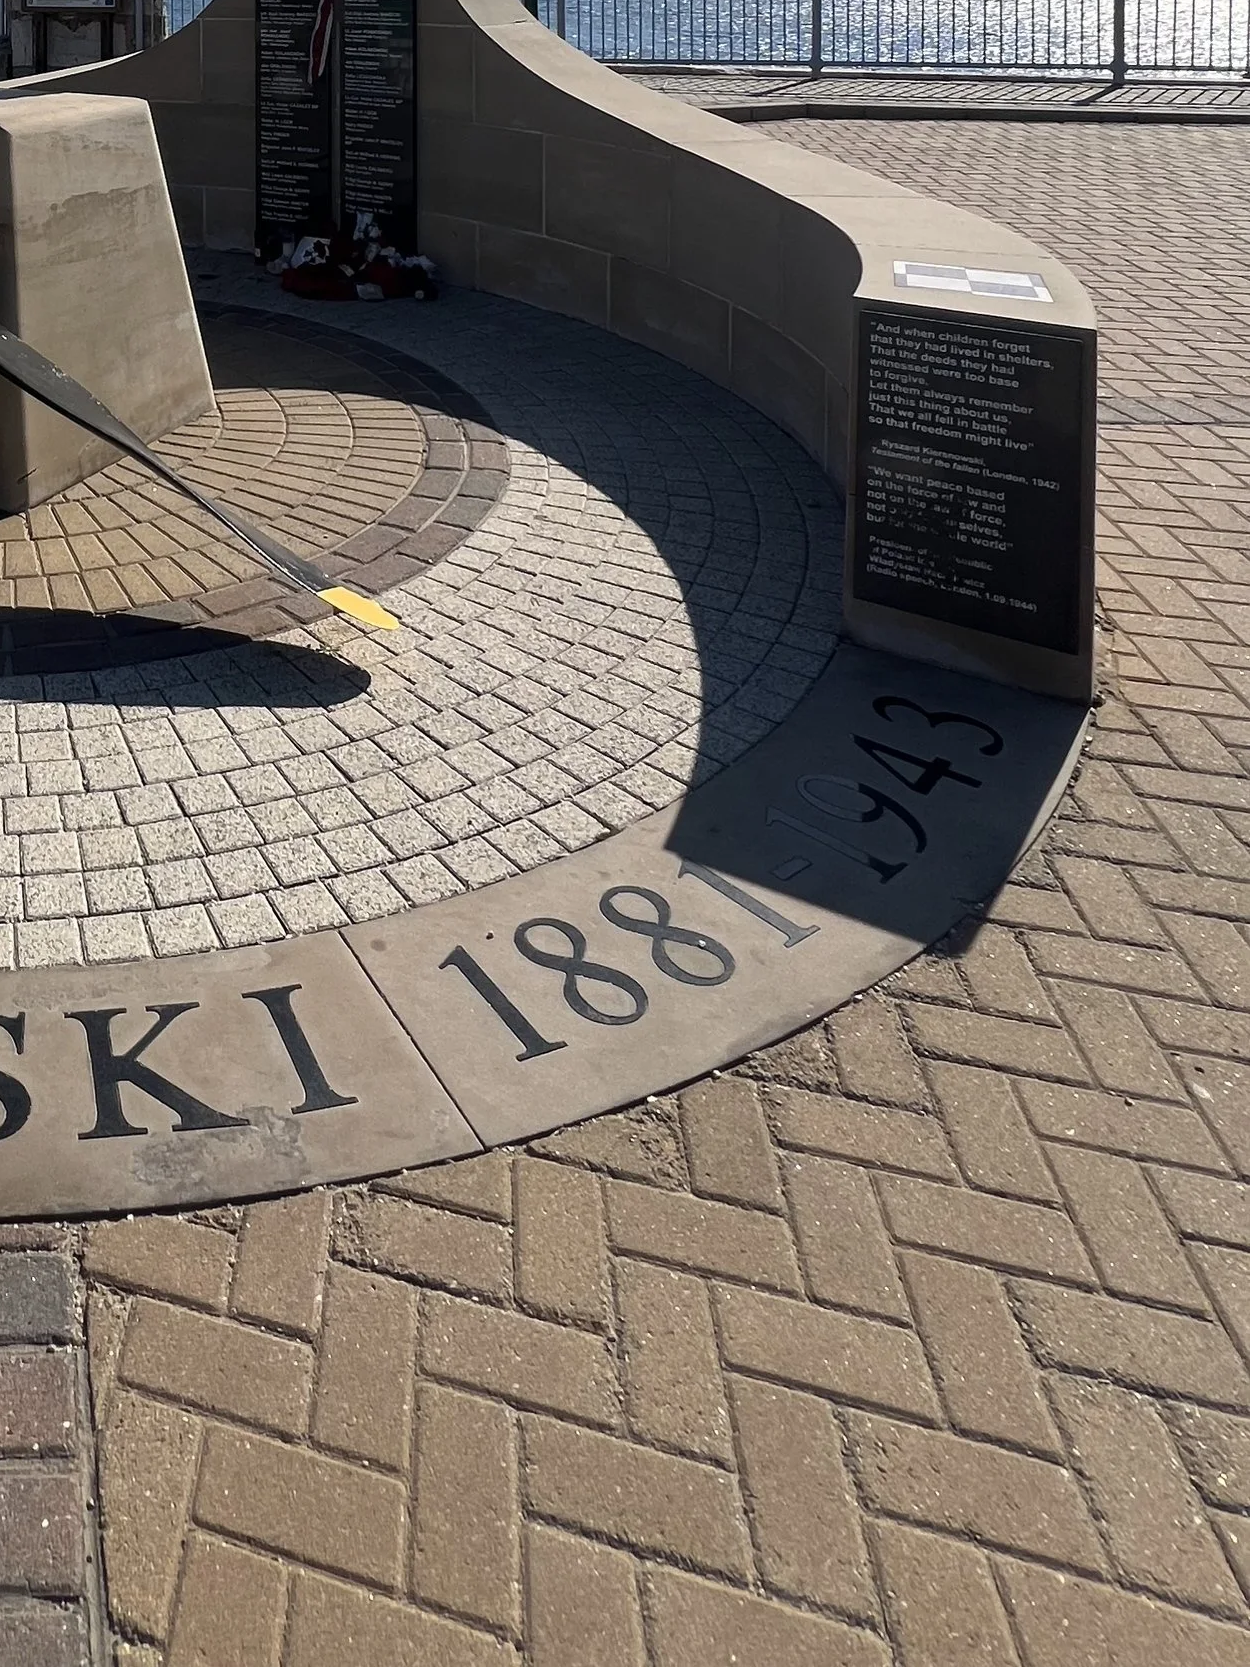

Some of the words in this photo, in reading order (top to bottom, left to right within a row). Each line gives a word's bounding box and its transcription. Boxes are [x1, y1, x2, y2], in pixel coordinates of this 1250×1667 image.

[870, 334, 892, 344] that
[896, 338, 921, 350] they
[925, 342, 947, 352] had
[951, 345, 980, 357] lived
[984, 350, 995, 359] in
[904, 328, 935, 339] when
[938, 333, 988, 346] children
[992, 339, 1030, 353] forget
[870, 344, 895, 356] That
[899, 350, 917, 359] the
[921, 353, 957, 366] deeds
[961, 359, 987, 372] they
[991, 363, 1015, 375] had
[870, 368, 881, 377] to
[870, 358, 929, 373] witnessed
[932, 368, 961, 379] were
[965, 372, 985, 382] too
[989, 375, 1019, 388] base
[868, 391, 891, 402] just
[894, 396, 916, 406] this
[919, 400, 950, 414] thing
[954, 407, 989, 419] about
[870, 380, 888, 390] Let
[891, 383, 920, 395] them
[923, 390, 965, 404] always
[969, 398, 1034, 414] remember
[868, 416, 883, 424] so
[886, 418, 908, 429] that
[912, 422, 962, 438] freedom
[965, 434, 1002, 446] might
[869, 402, 894, 415] That
[898, 410, 914, 418] we
[918, 413, 931, 421] all
[935, 414, 953, 425] fell
[957, 418, 968, 428] in
[972, 420, 1007, 435] battle
[872, 446, 920, 462] Testament
[935, 460, 950, 468] the
[952, 462, 980, 474] fallen
[867, 479, 882, 487] on
[885, 481, 903, 491] the
[908, 485, 938, 498] force
[941, 494, 954, 502] of
[982, 503, 1006, 513] and
[867, 490, 886, 501] not
[889, 495, 904, 503] on
[895, 473, 923, 484] want
[927, 479, 963, 492] peace
[967, 485, 1005, 501] based
[867, 502, 886, 512] not
